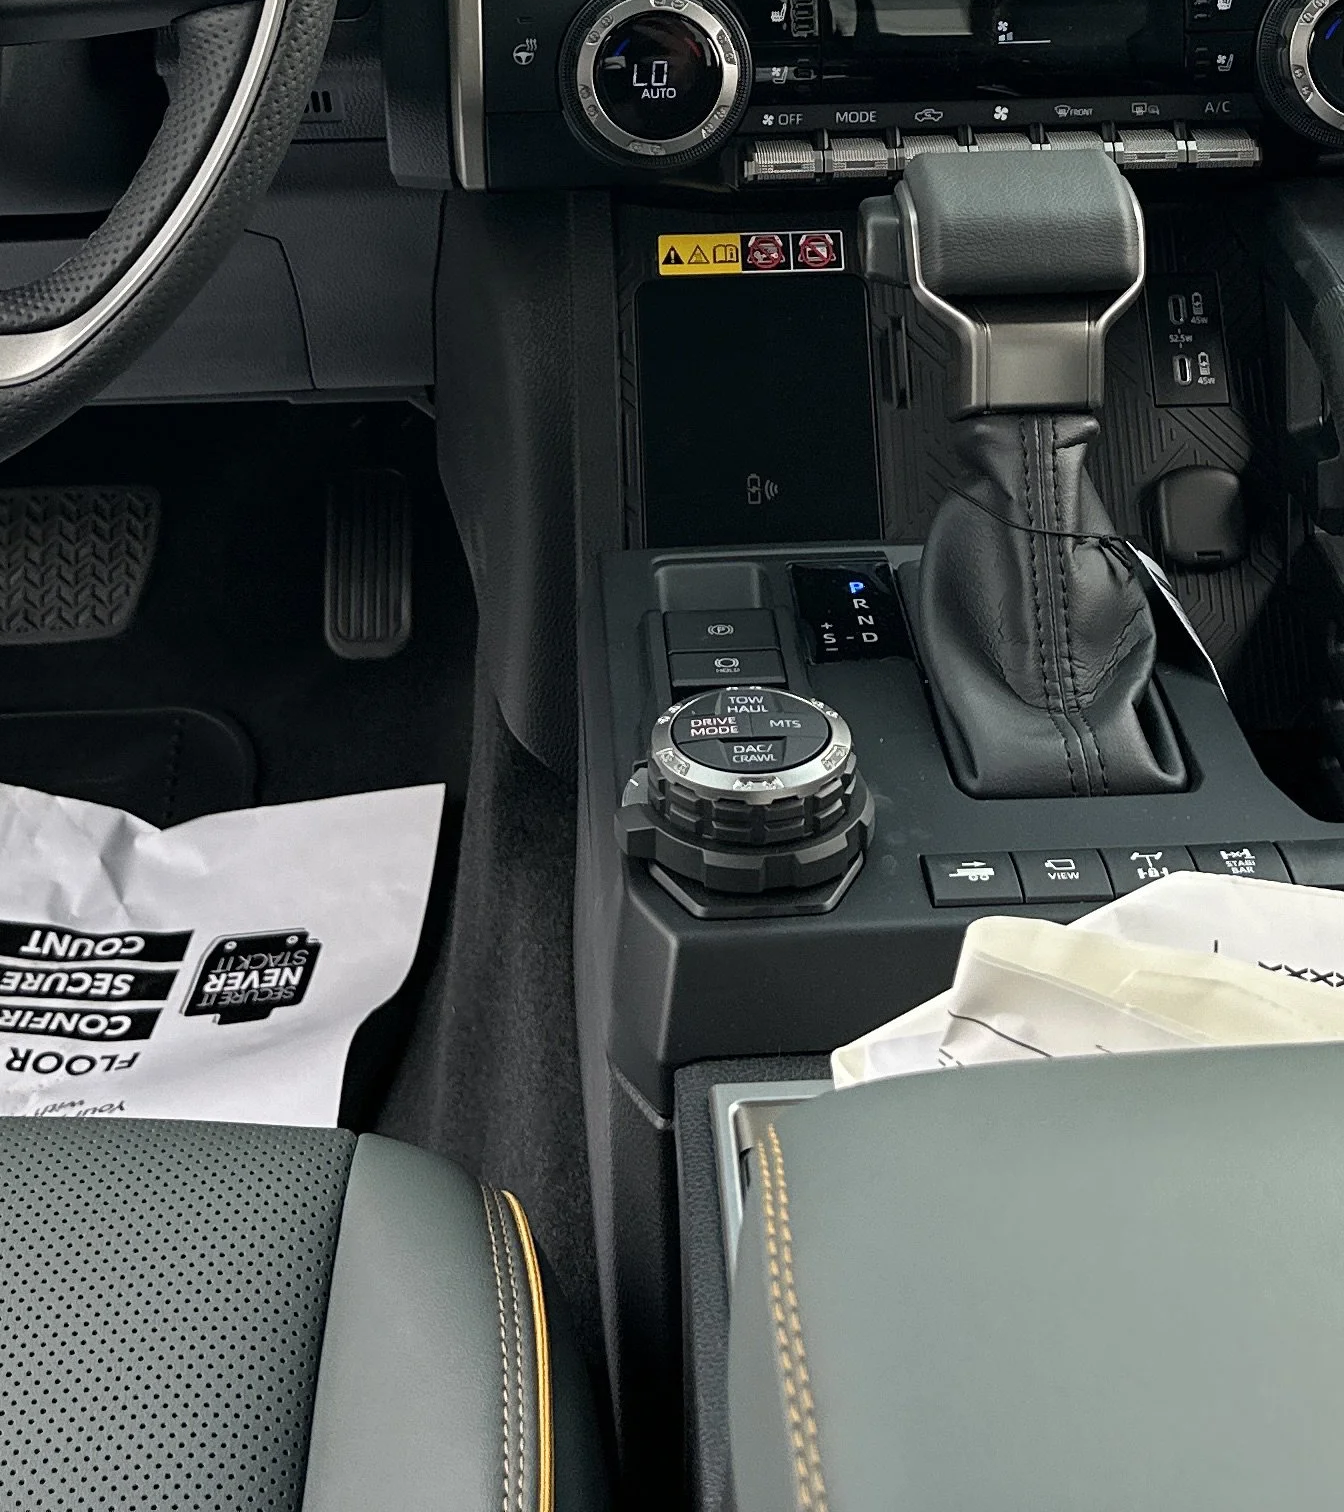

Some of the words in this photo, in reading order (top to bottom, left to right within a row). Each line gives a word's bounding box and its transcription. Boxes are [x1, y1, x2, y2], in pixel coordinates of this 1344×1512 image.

[641, 88, 677, 99] AUTO
[1205, 100, 1231, 113] A/C
[778, 113, 803, 126] OFF
[835, 111, 877, 124] MODE
[849, 581, 864, 593] P
[853, 598, 870, 609] R
[857, 614, 874, 625] N
[862, 632, 878, 643] D
[728, 695, 764, 705] TOW
[727, 704, 769, 714] HAUL
[690, 716, 737, 727] DRIVE
[769, 719, 802, 729] MTS
[690, 726, 739, 737] MODE
[733, 743, 773, 754] DAC/
[732, 753, 777, 763] CRAWL
[1047, 869, 1080, 881] VIEW
[19, 930, 145, 957] COUNT
[210, 955, 235, 973] IT
[236, 949, 309, 970] STACK
[202, 966, 304, 993] NEVER
[217, 985, 296, 1005] SECURE
[5, 1047, 140, 1076] FLOOR
